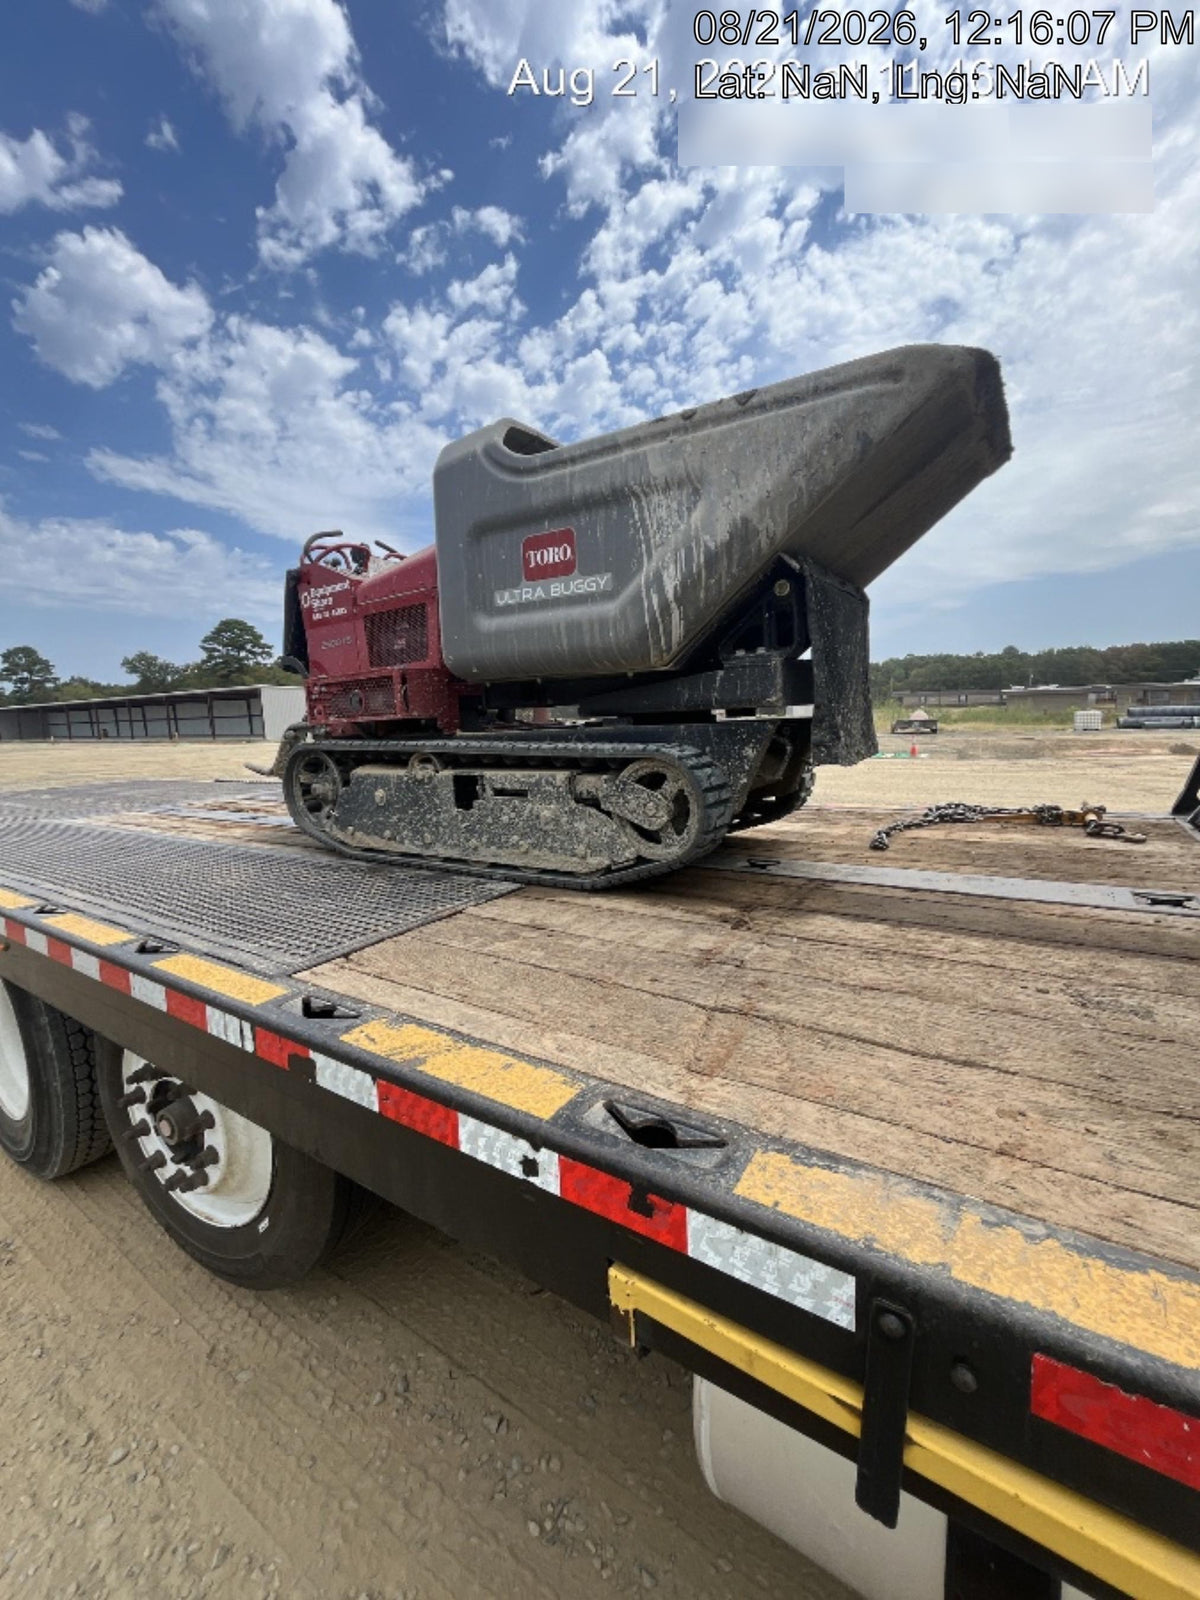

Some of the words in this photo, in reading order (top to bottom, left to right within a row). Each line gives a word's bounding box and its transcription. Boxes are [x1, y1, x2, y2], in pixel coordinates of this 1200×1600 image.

[525, 543, 572, 568] TORO
[495, 587, 545, 606] ULTRA
[550, 575, 608, 597] BUGGY
